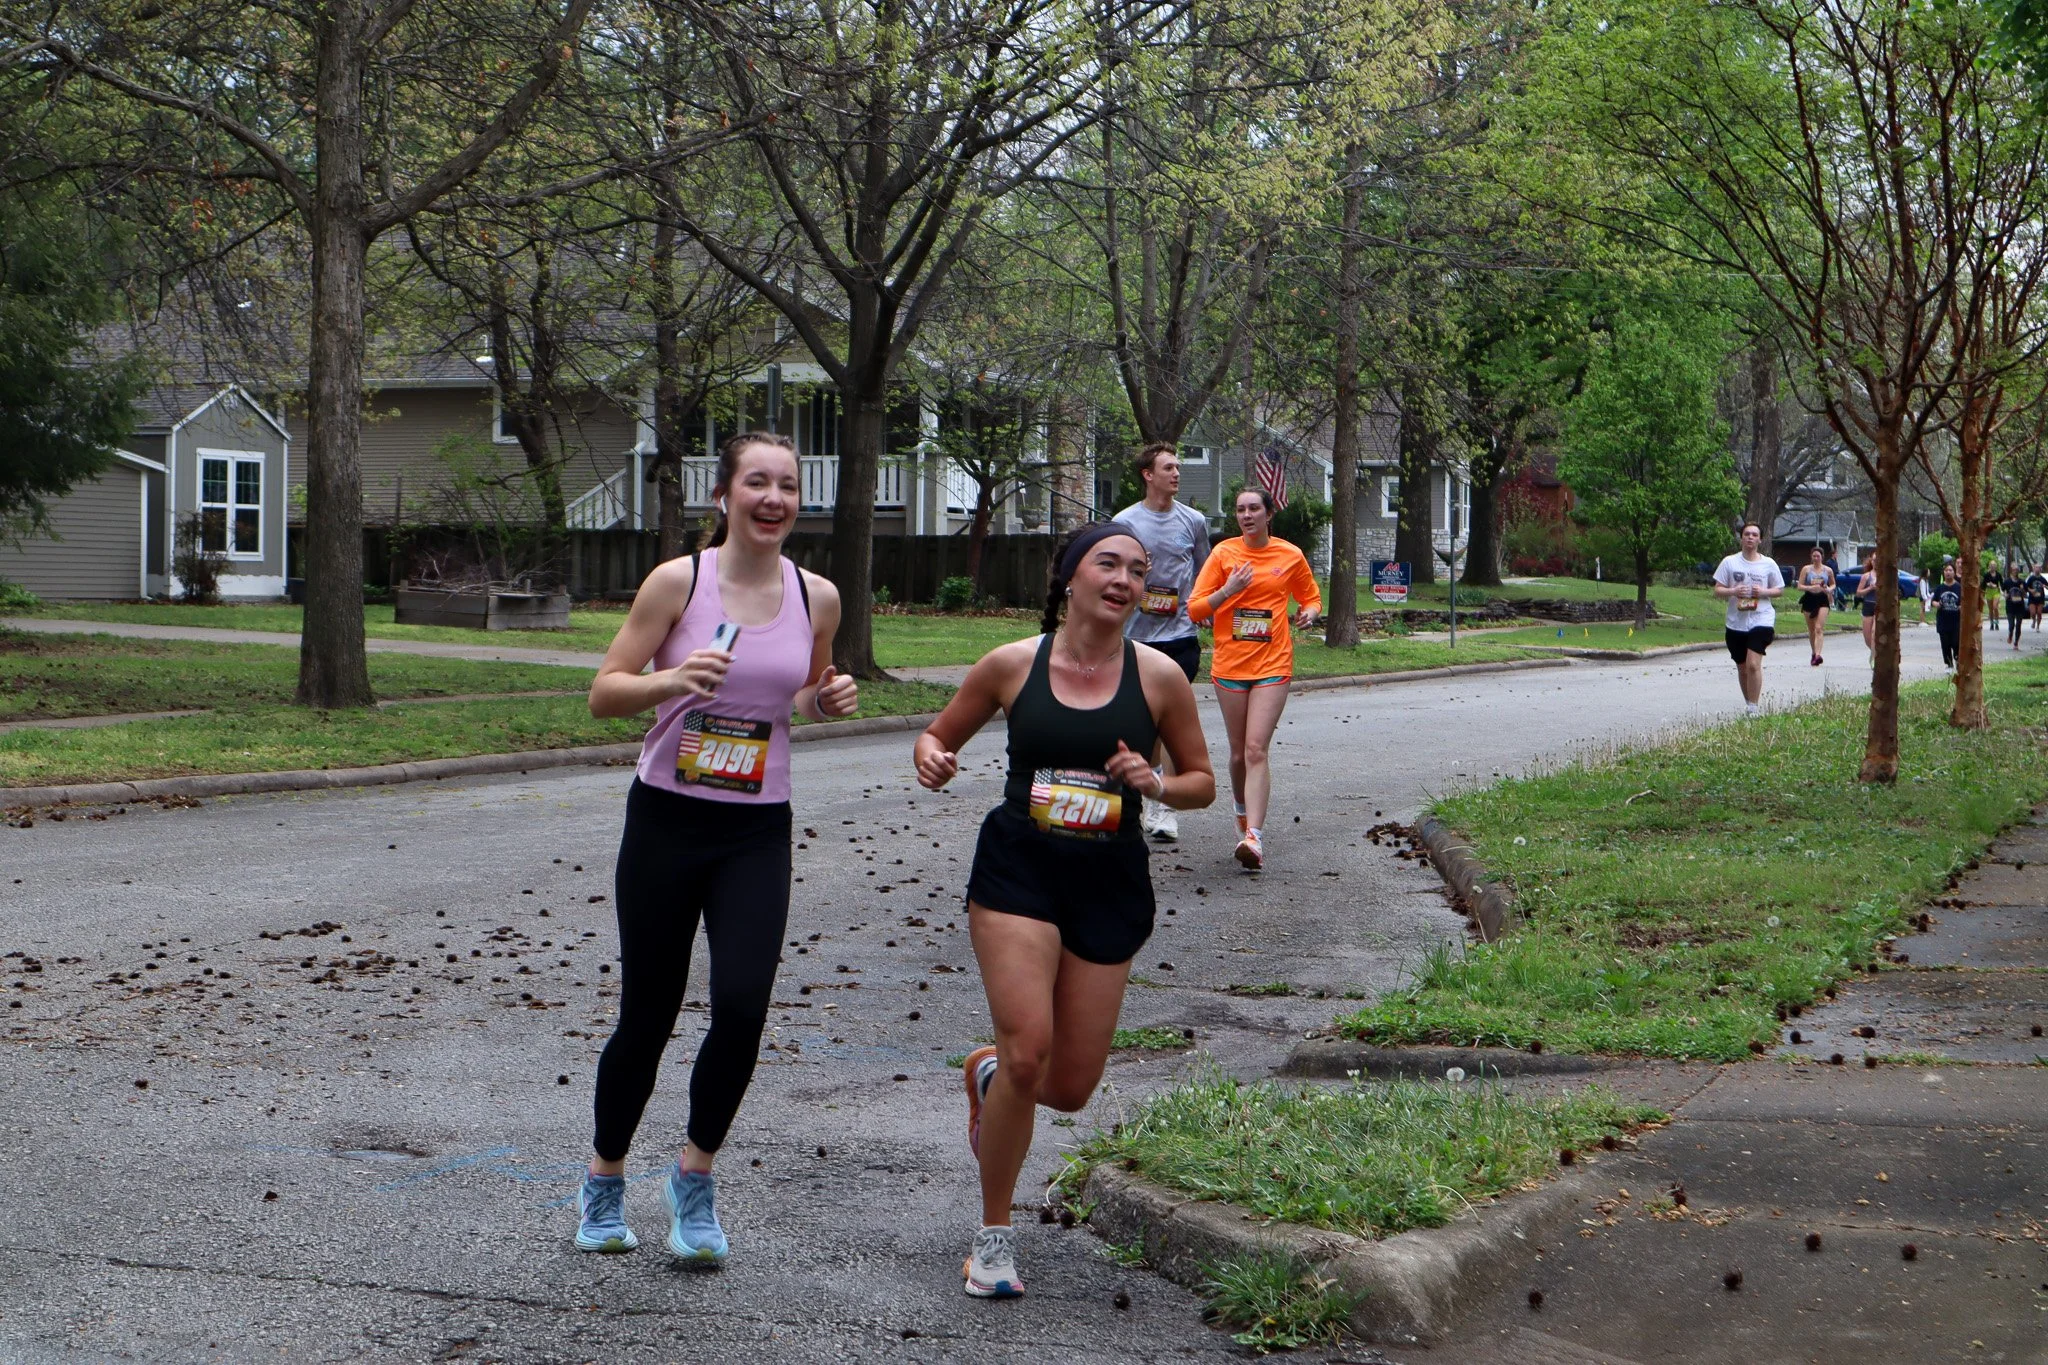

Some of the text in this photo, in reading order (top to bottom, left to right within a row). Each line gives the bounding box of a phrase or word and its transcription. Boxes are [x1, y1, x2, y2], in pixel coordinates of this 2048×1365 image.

[1240, 620, 1268, 635] 2274
[695, 739, 759, 775] 2096
[1047, 790, 1109, 825] 2210
